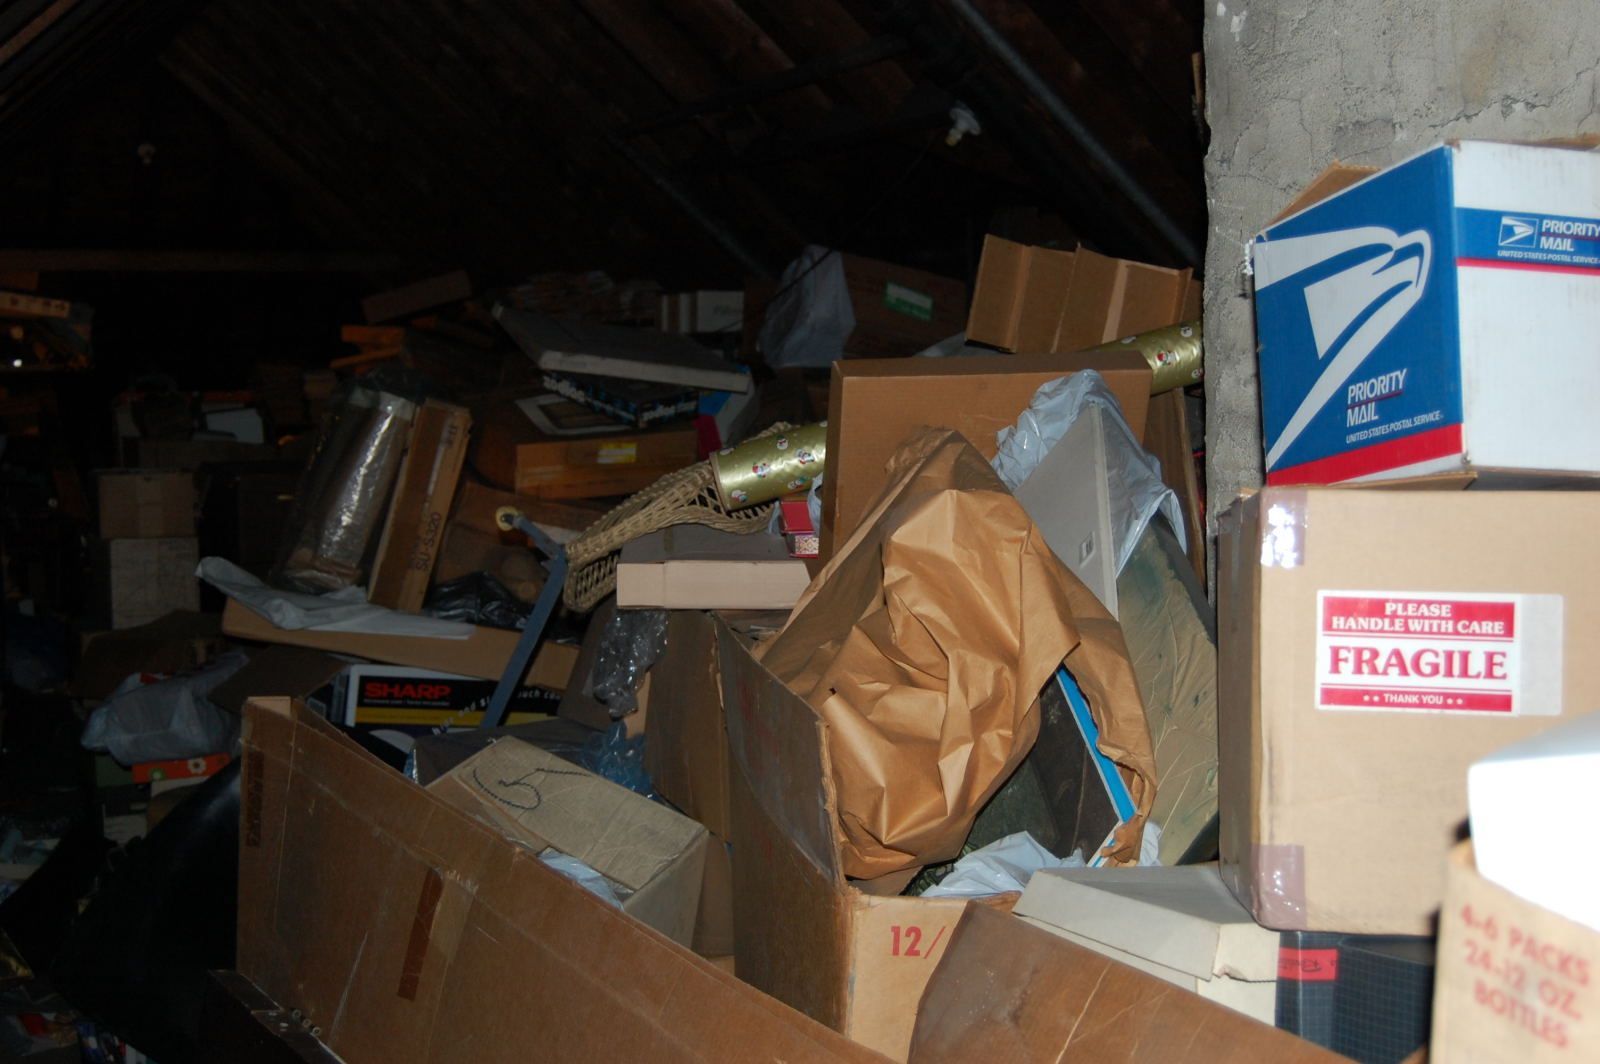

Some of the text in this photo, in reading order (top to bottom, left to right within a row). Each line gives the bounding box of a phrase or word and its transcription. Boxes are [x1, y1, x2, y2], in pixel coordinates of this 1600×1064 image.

[1541, 219, 1600, 238] PRIORITY
[1540, 236, 1574, 252] MAIL
[1497, 250, 1598, 265] UNITED STATES POSTAL SERVICE
[1347, 368, 1407, 405] PRIORITY
[1346, 401, 1379, 428] MAIL
[1346, 410, 1441, 444] UNITED STATES POSTAL SERVICE
[1385, 601, 1452, 617] PLEASE
[1331, 616, 1505, 634] HANDLE WITH CARE
[1328, 645, 1508, 680] FRAGILE
[363, 682, 450, 699] SHARP
[1383, 693, 1443, 705] THANK YOU
[1509, 925, 1590, 987] PACKS
[1474, 977, 1569, 1048] BOTTLES
